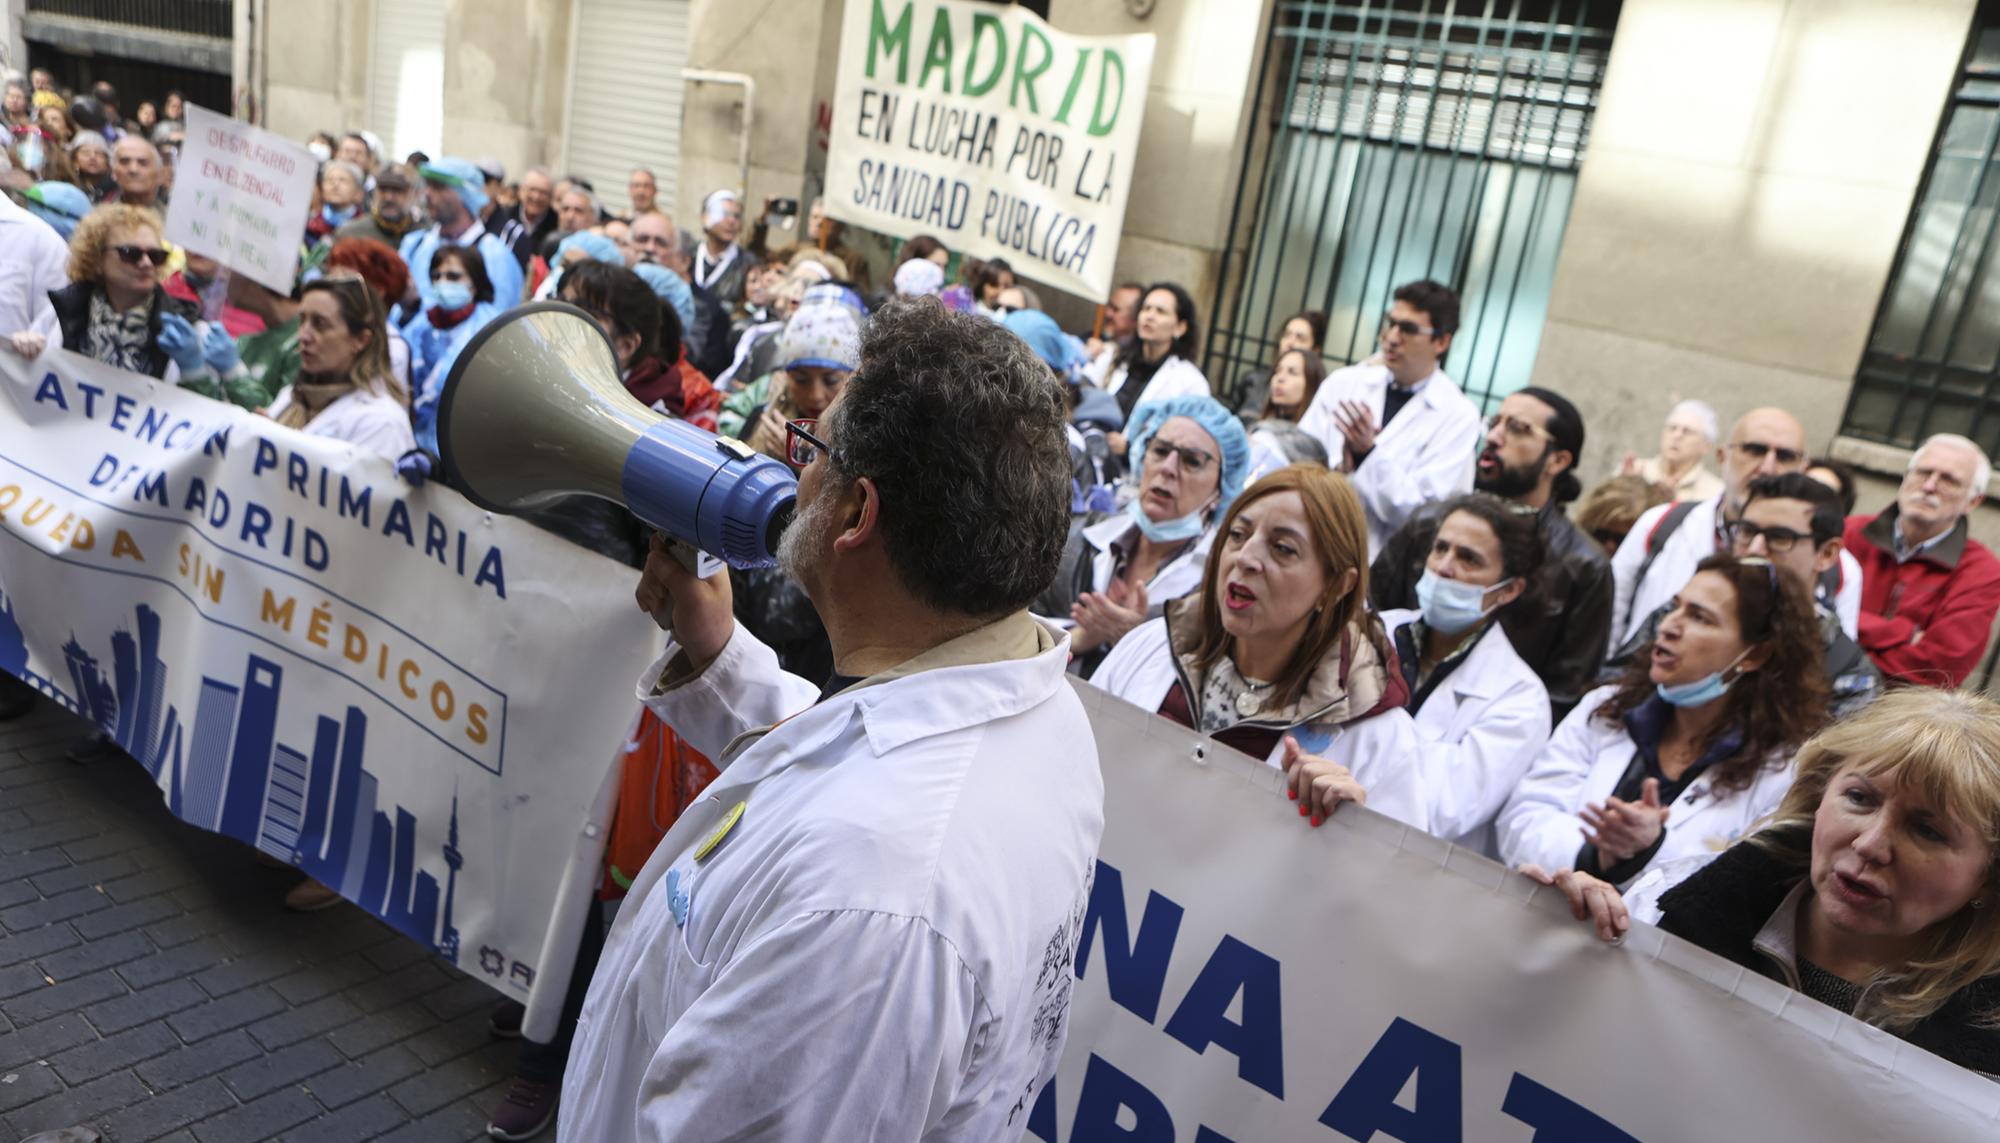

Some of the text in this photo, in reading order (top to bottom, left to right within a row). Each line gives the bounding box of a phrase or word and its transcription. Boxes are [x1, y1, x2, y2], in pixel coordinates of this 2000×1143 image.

[865, 0, 1125, 138] MADRID
[854, 159, 971, 231] SANIDAD
[858, 90, 899, 146] EN
[908, 101, 999, 169] LUCHA
[1006, 125, 1064, 189] POR
[1075, 149, 1116, 206] LA
[34, 371, 507, 600] ATENCN PRIMARIA
[134, 470, 331, 573] MADRID
[0, 484, 489, 745] QUEDA SIN MÉDICOS
